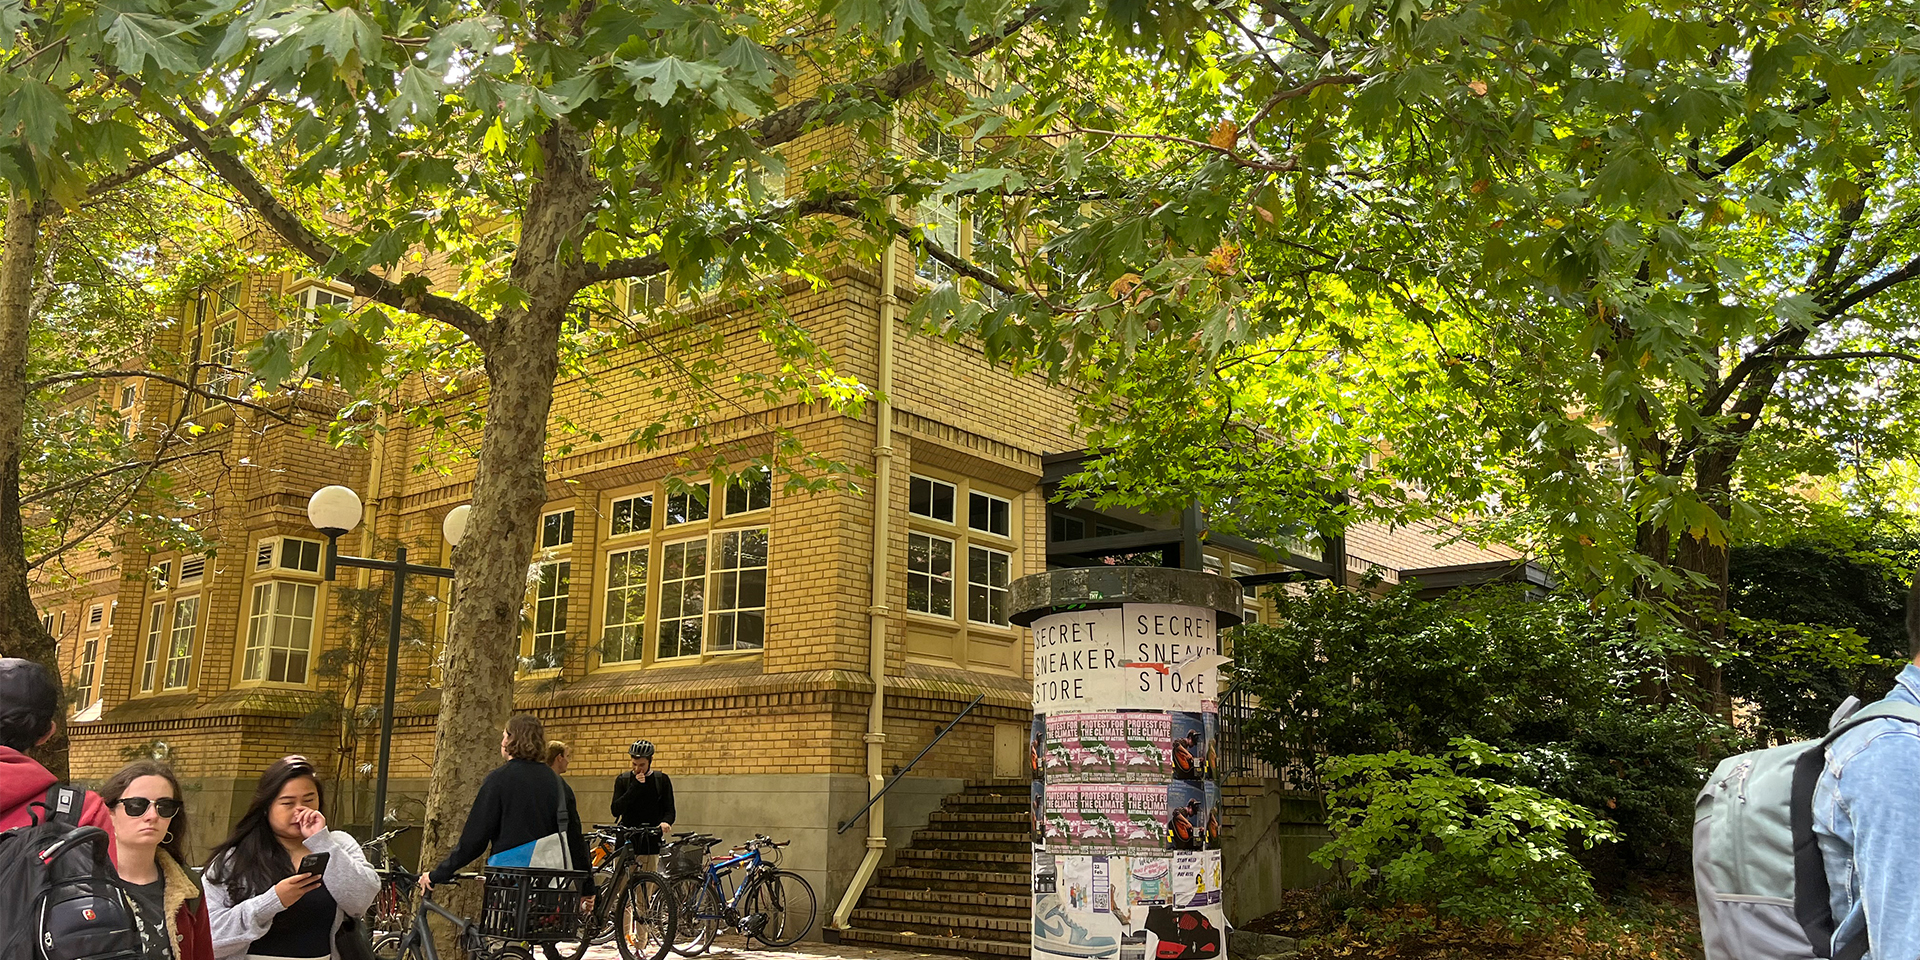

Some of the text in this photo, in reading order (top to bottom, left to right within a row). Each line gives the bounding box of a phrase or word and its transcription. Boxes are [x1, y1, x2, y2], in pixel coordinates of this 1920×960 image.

[1138, 614, 1210, 639] SECRET
[1036, 622, 1096, 650] SECRET
[1138, 643, 1215, 664] SNEAK
[1036, 649, 1116, 676] SNEAKER
[1036, 678, 1084, 704] STORE
[1081, 720, 1124, 728] PROTEST FOR
[1128, 720, 1170, 730] PROTEST FOR
[1082, 728, 1124, 736] THE CLIMATE
[1142, 728, 1170, 738] CLIMATE
[1081, 792, 1124, 800] PROTEST FOR
[1128, 792, 1158, 802] PROTEST
[1160, 794, 1168, 802] FO
[1081, 800, 1124, 809] THE CLIMATE
[1128, 802, 1168, 810] THE CLIMAT
